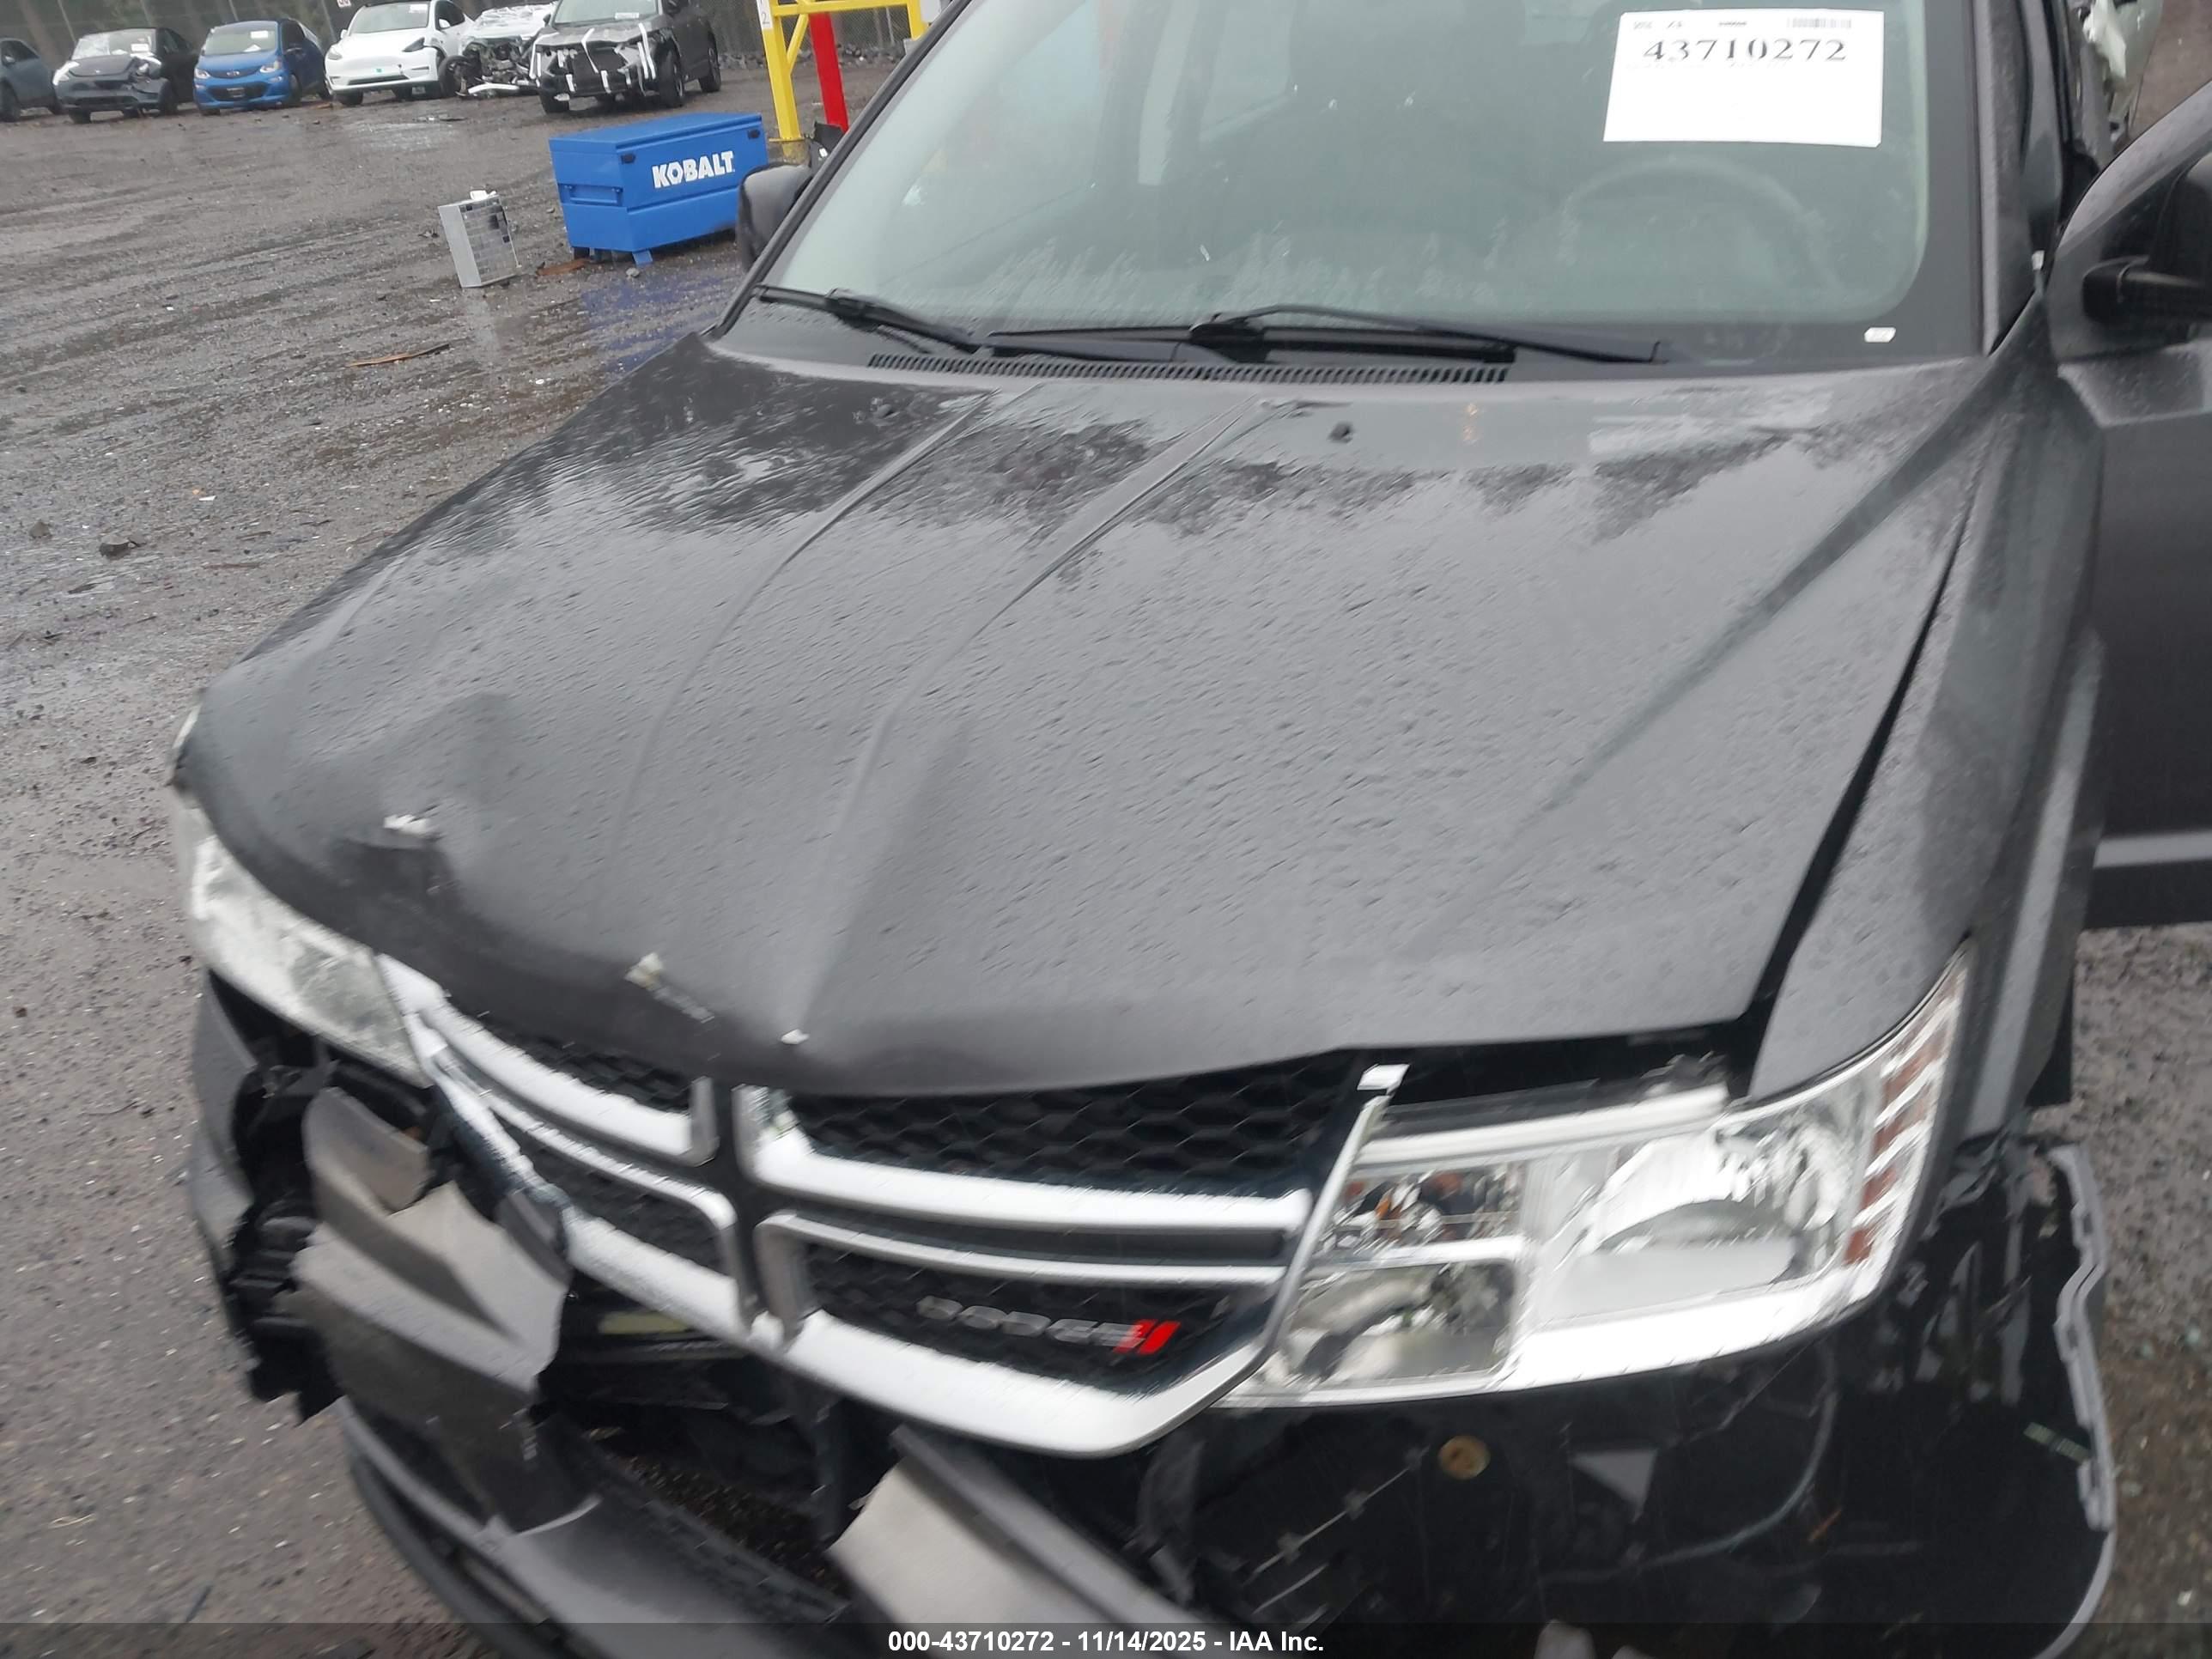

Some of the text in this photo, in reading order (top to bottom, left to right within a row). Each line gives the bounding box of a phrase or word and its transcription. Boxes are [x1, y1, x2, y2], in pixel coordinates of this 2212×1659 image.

[1643, 38, 1846, 61] 43710272
[652, 150, 733, 188] KOBALT
[915, 1295, 1146, 1348] DODGE
